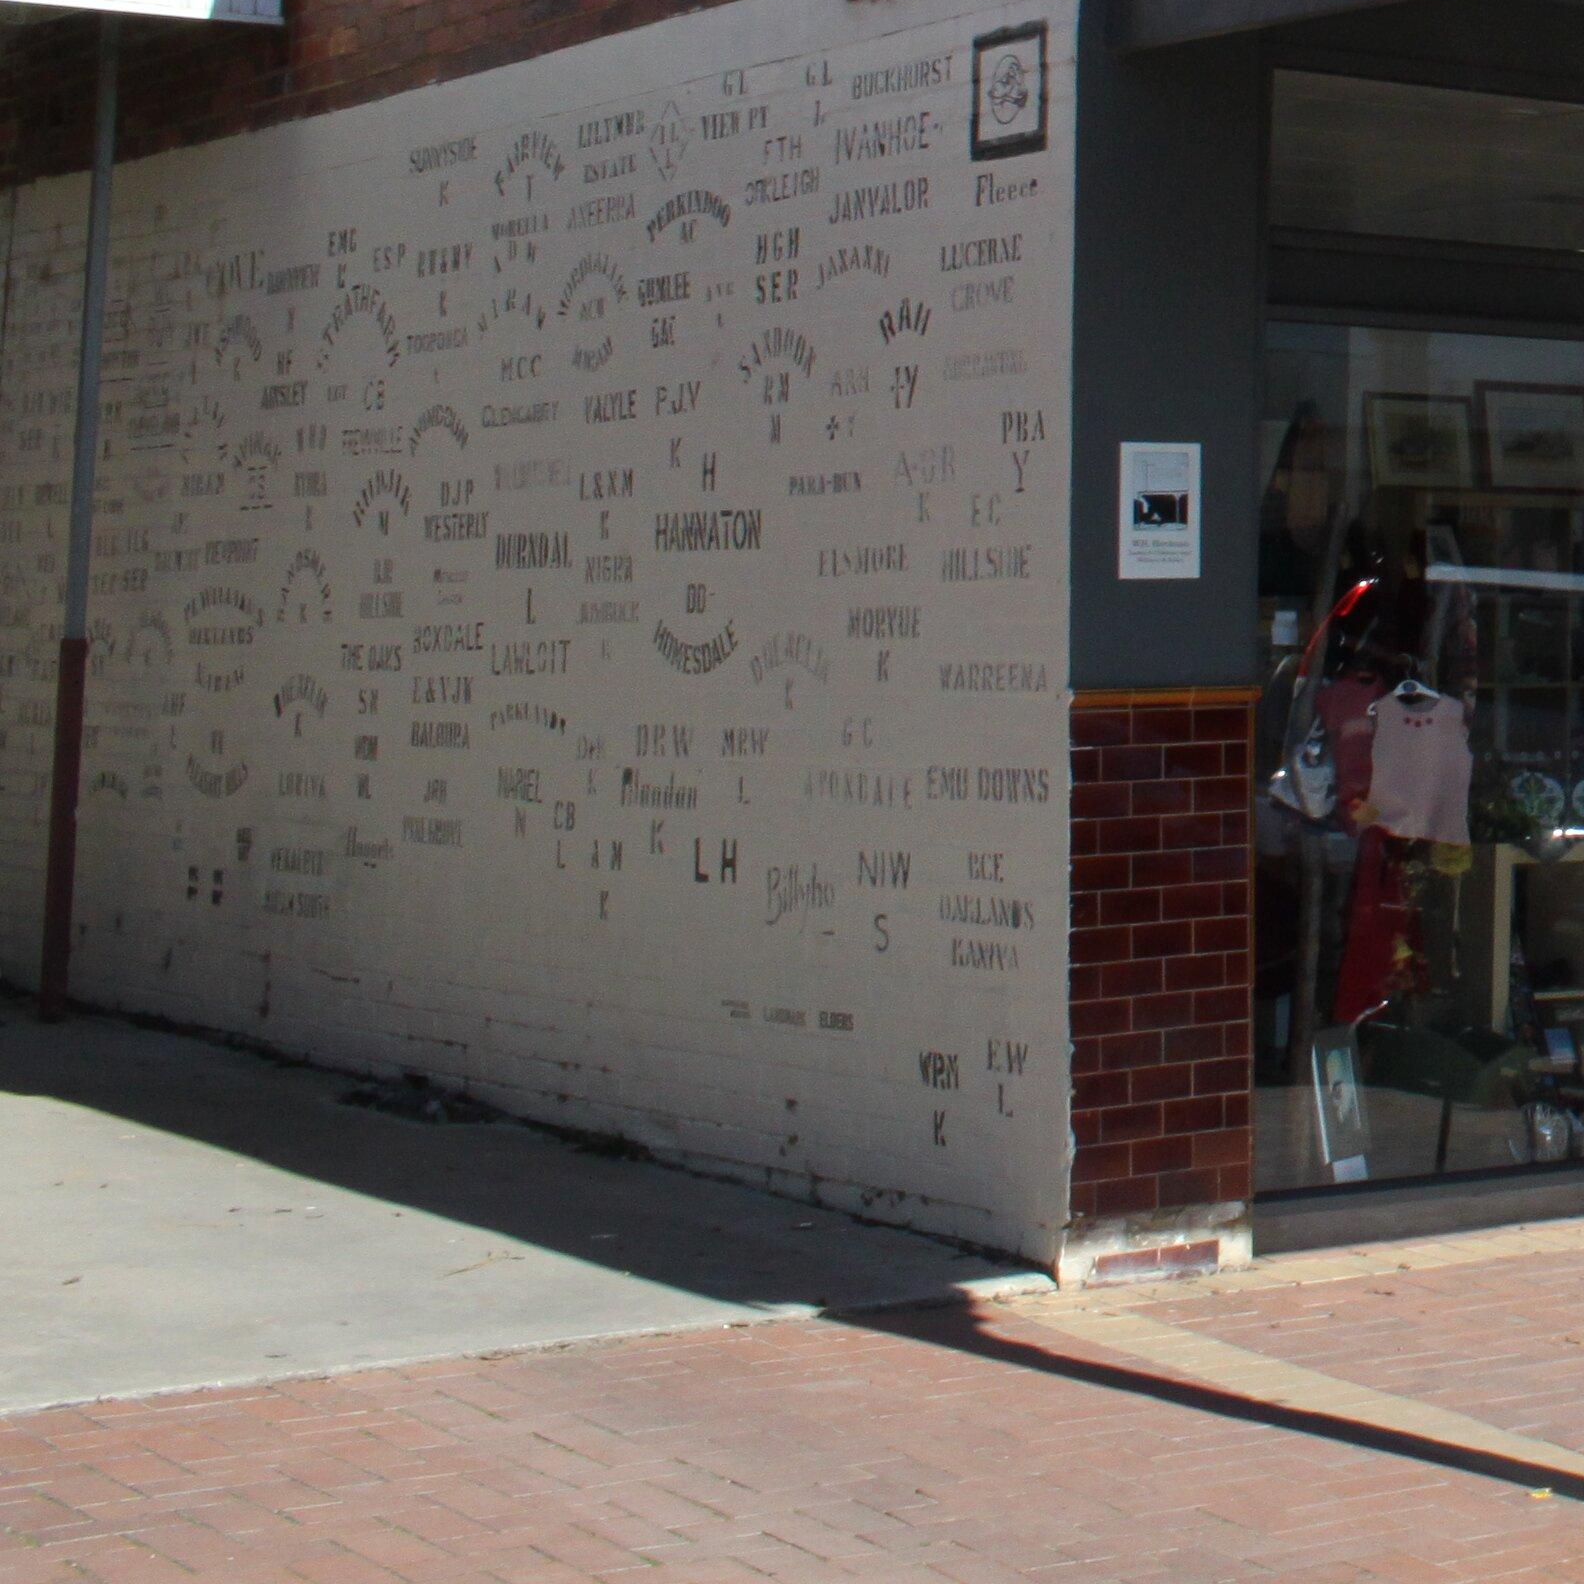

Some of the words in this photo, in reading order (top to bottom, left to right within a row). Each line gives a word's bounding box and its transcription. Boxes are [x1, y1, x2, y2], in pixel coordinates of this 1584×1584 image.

[851, 54, 954, 101] BUCKHURST
[974, 172, 1040, 208] Fleece
[939, 233, 1024, 273] LUCERNE
[755, 267, 800, 305] SER
[1001, 410, 1047, 446] PBA
[701, 451, 718, 493] H
[1012, 449, 1032, 494] Y
[941, 544, 1032, 583] HILLSIDE
[525, 587, 537, 625] L
[652, 618, 740, 676] HOMESDALE
[876, 649, 891, 683] K
[925, 764, 969, 801] EMU
[976, 765, 1051, 805] DOWNS
[872, 913, 891, 954] S
[818, 1010, 854, 1032] ELDERS
